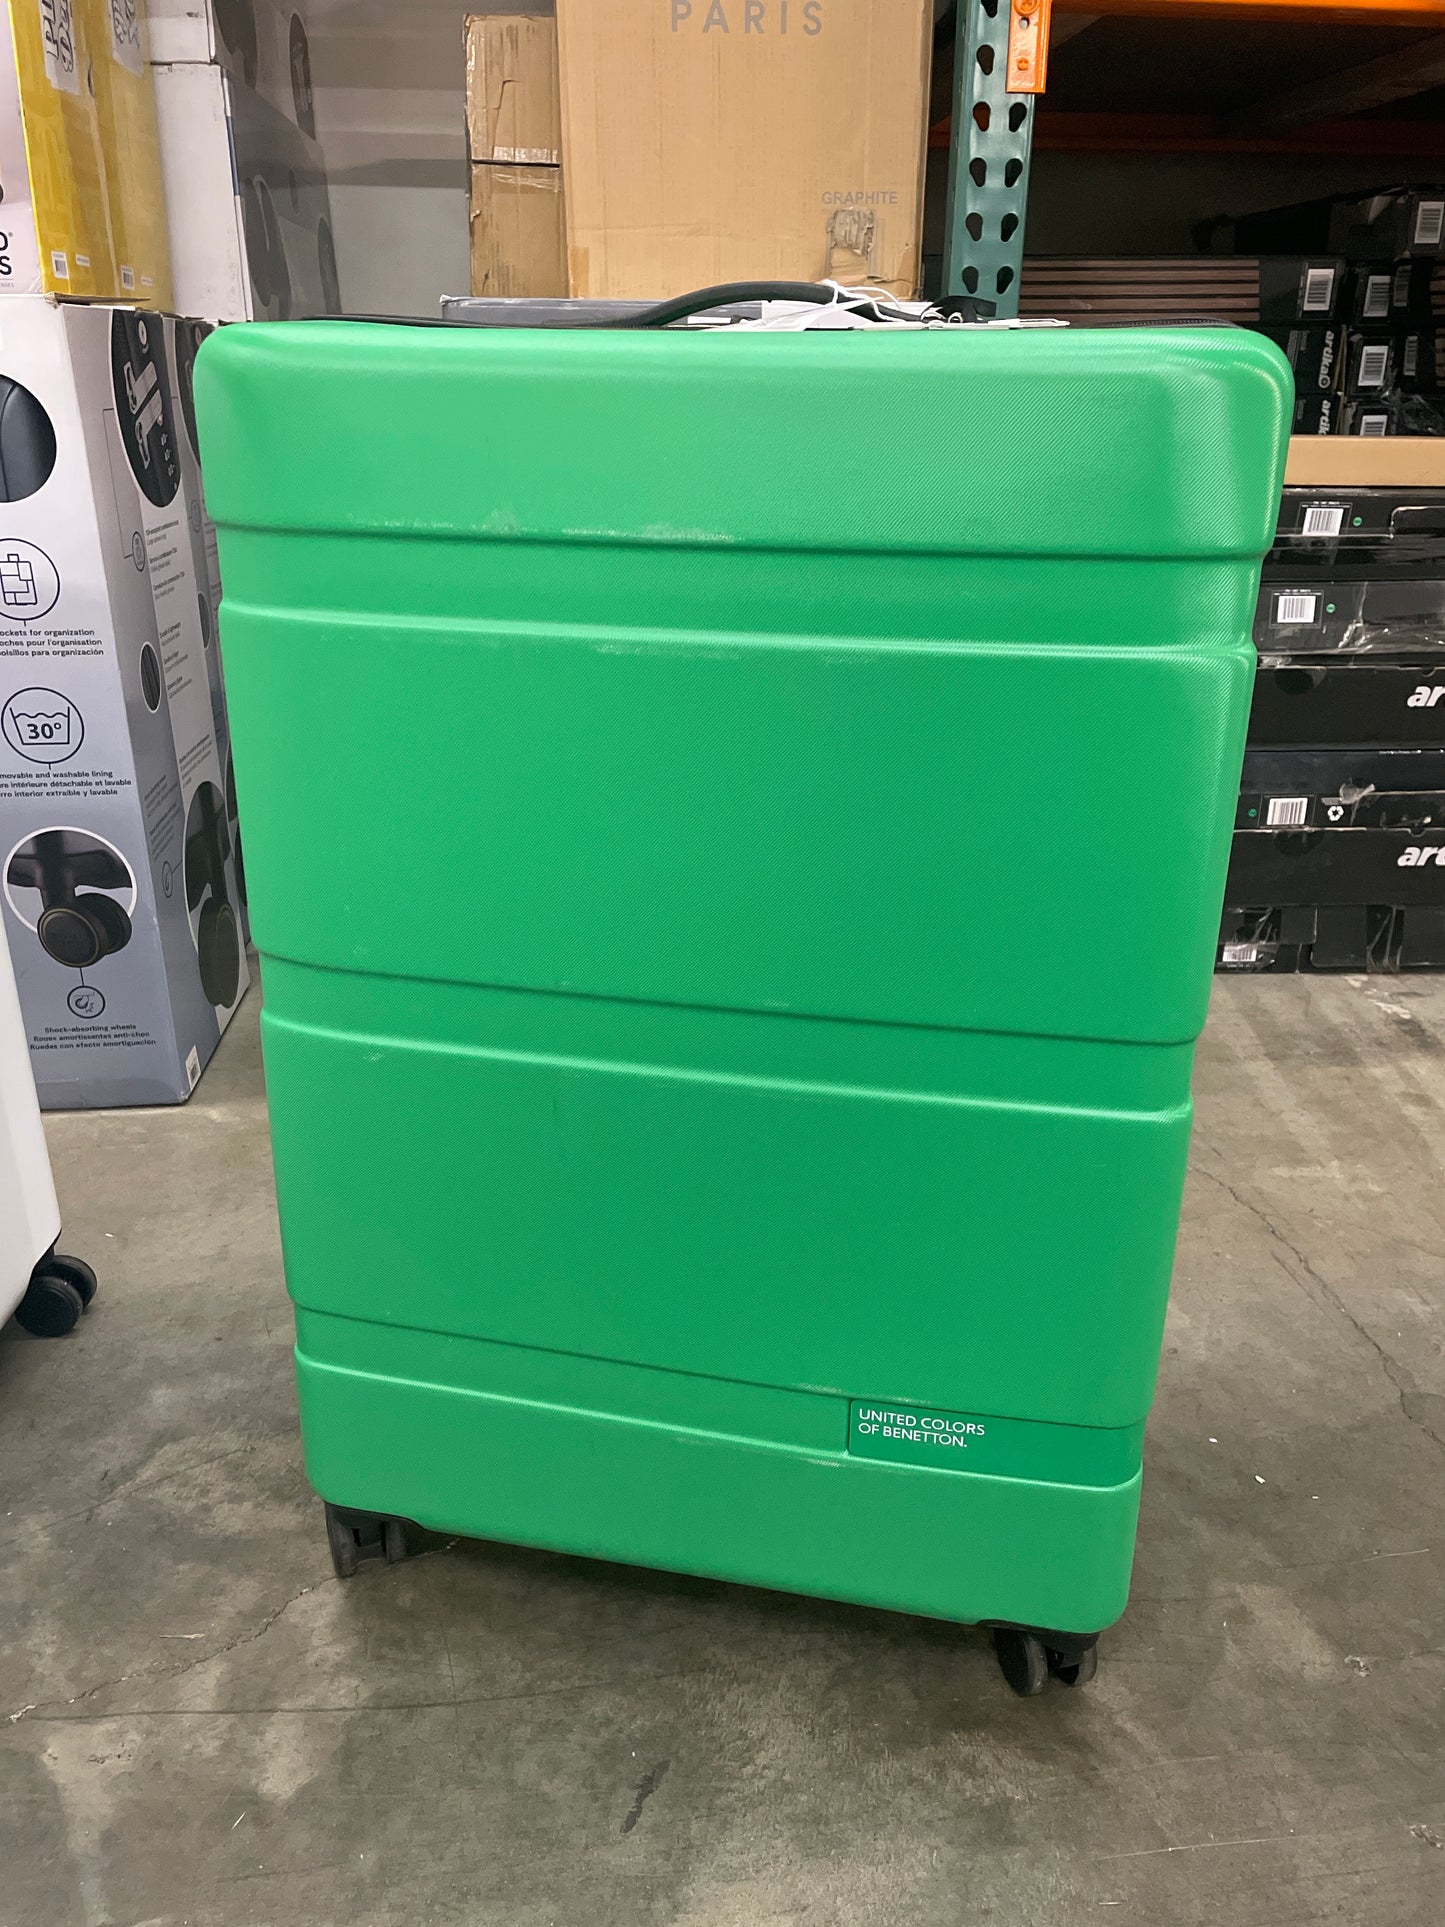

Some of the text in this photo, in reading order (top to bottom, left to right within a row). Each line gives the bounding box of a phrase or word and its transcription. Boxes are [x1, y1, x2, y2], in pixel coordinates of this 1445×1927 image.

[671, 0, 823, 36] PARIS
[822, 191, 898, 205] GRAPHITE
[44, 628, 95, 637] organization
[53, 770, 90, 778] washable
[92, 770, 114, 778] lining
[90, 788, 118, 796] lavable
[859, 1408, 985, 1436] UNITED COLORS
[858, 1422, 968, 1448] OF BENETTON.
